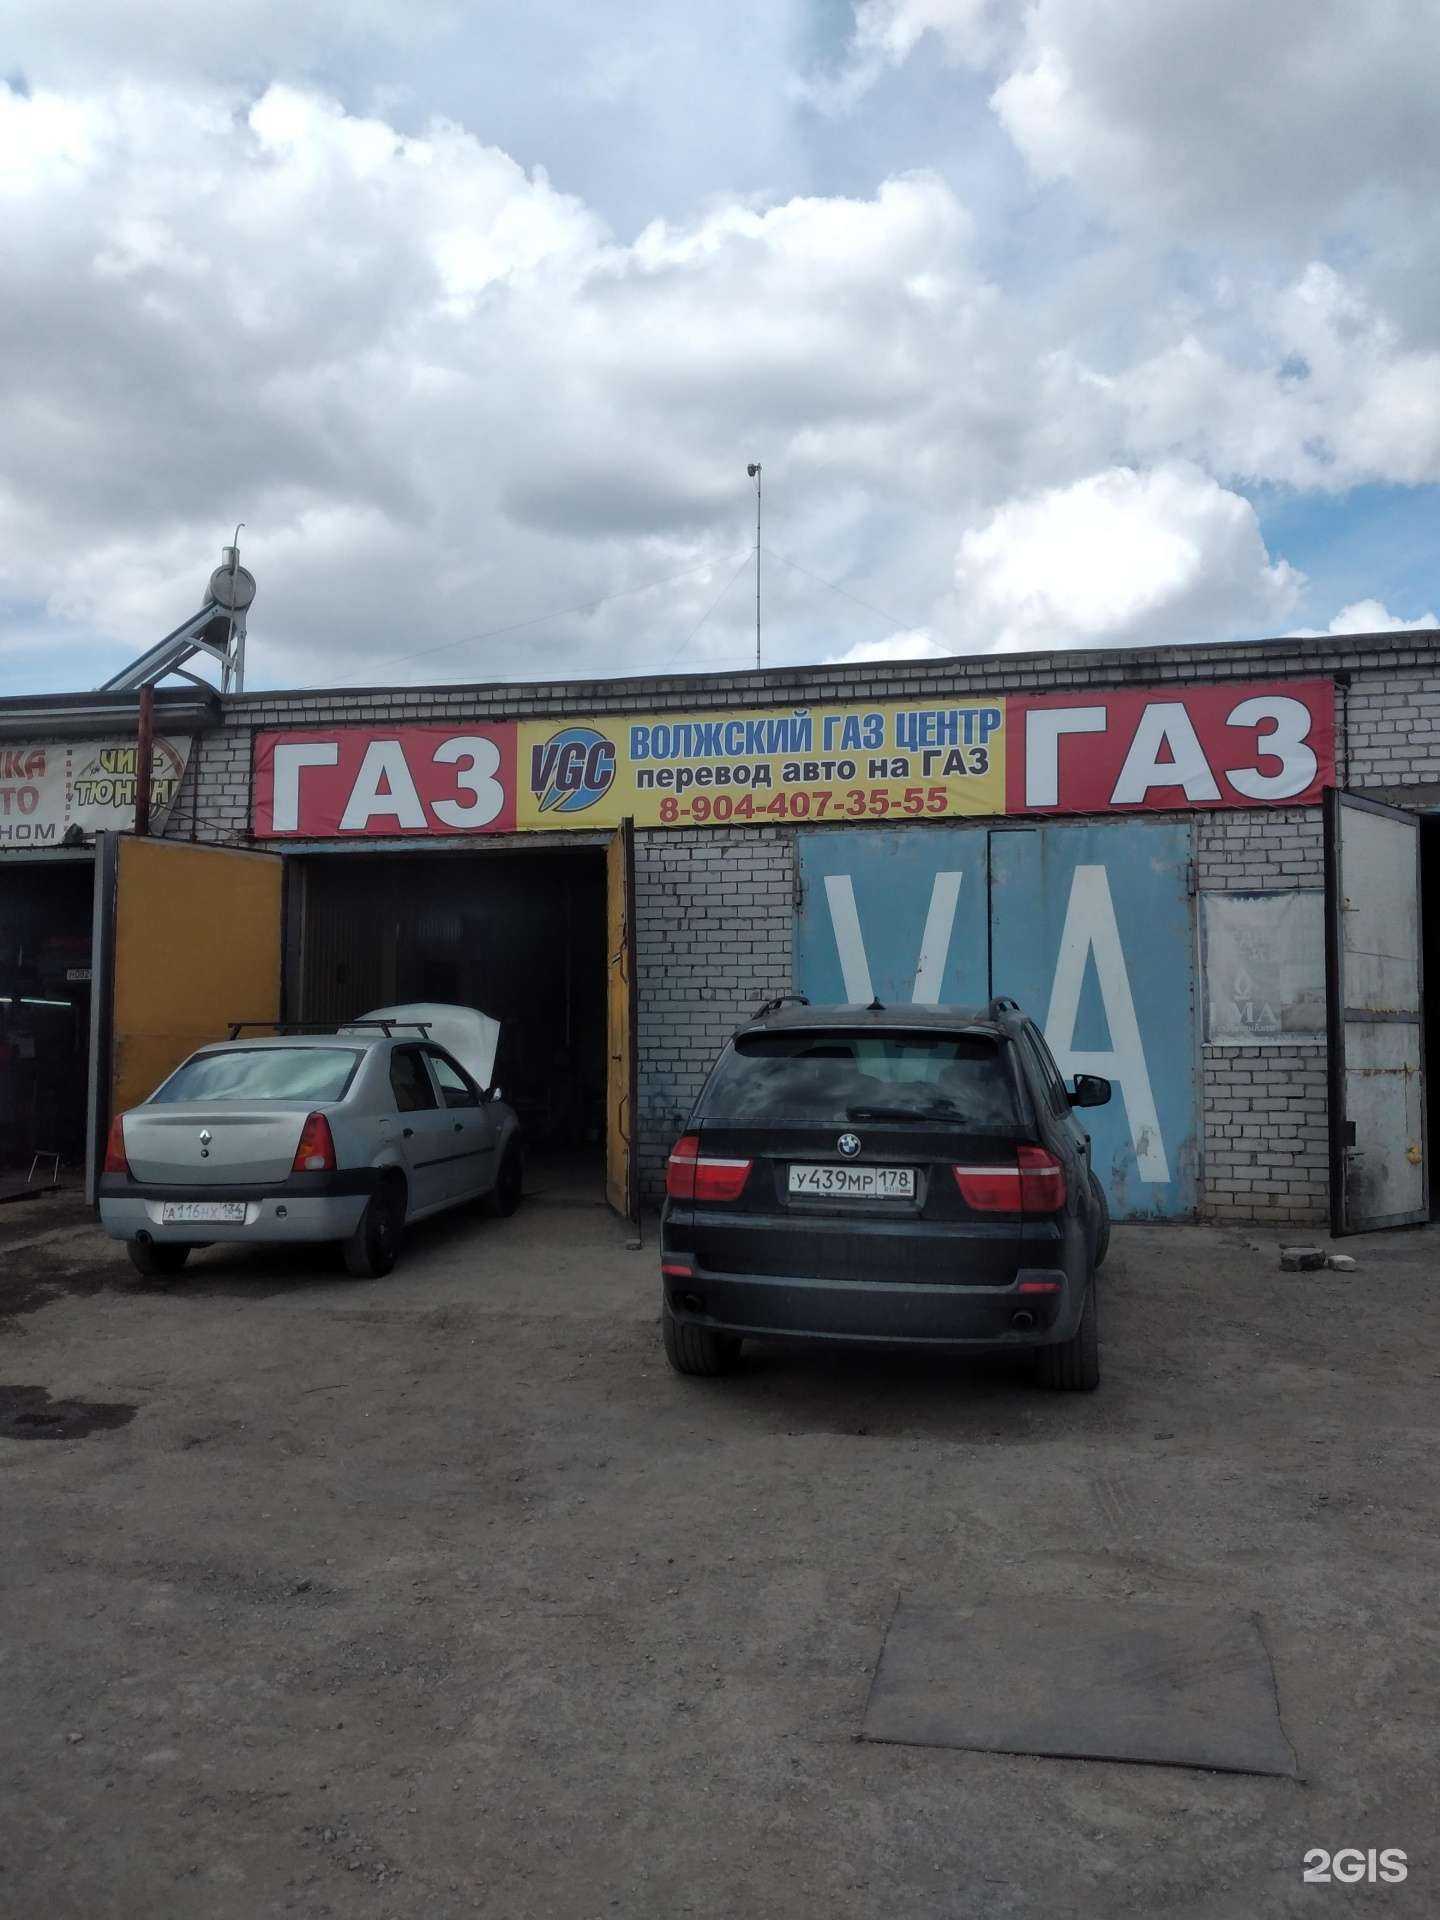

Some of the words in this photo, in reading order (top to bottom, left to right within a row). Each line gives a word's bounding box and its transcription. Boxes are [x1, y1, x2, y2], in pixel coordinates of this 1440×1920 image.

[630, 710, 813, 761] ВОЛЖСКИЙ
[823, 713, 884, 751] ГАЗ
[896, 708, 1001, 752] ЦЕНТР
[1026, 695, 1318, 808] ГАЗ
[0, 751, 47, 779] КА
[272, 735, 505, 832] ГАЗ
[530, 740, 616, 792] VGC
[636, 763, 772, 793] перевод
[782, 759, 856, 783] авто
[869, 758, 909, 779] на
[922, 748, 989, 776] ГАЗ
[659, 786, 948, 823] 8-904-407-35-55
[797, 1169, 874, 1191] У439МР
[878, 1171, 908, 1187] 178
